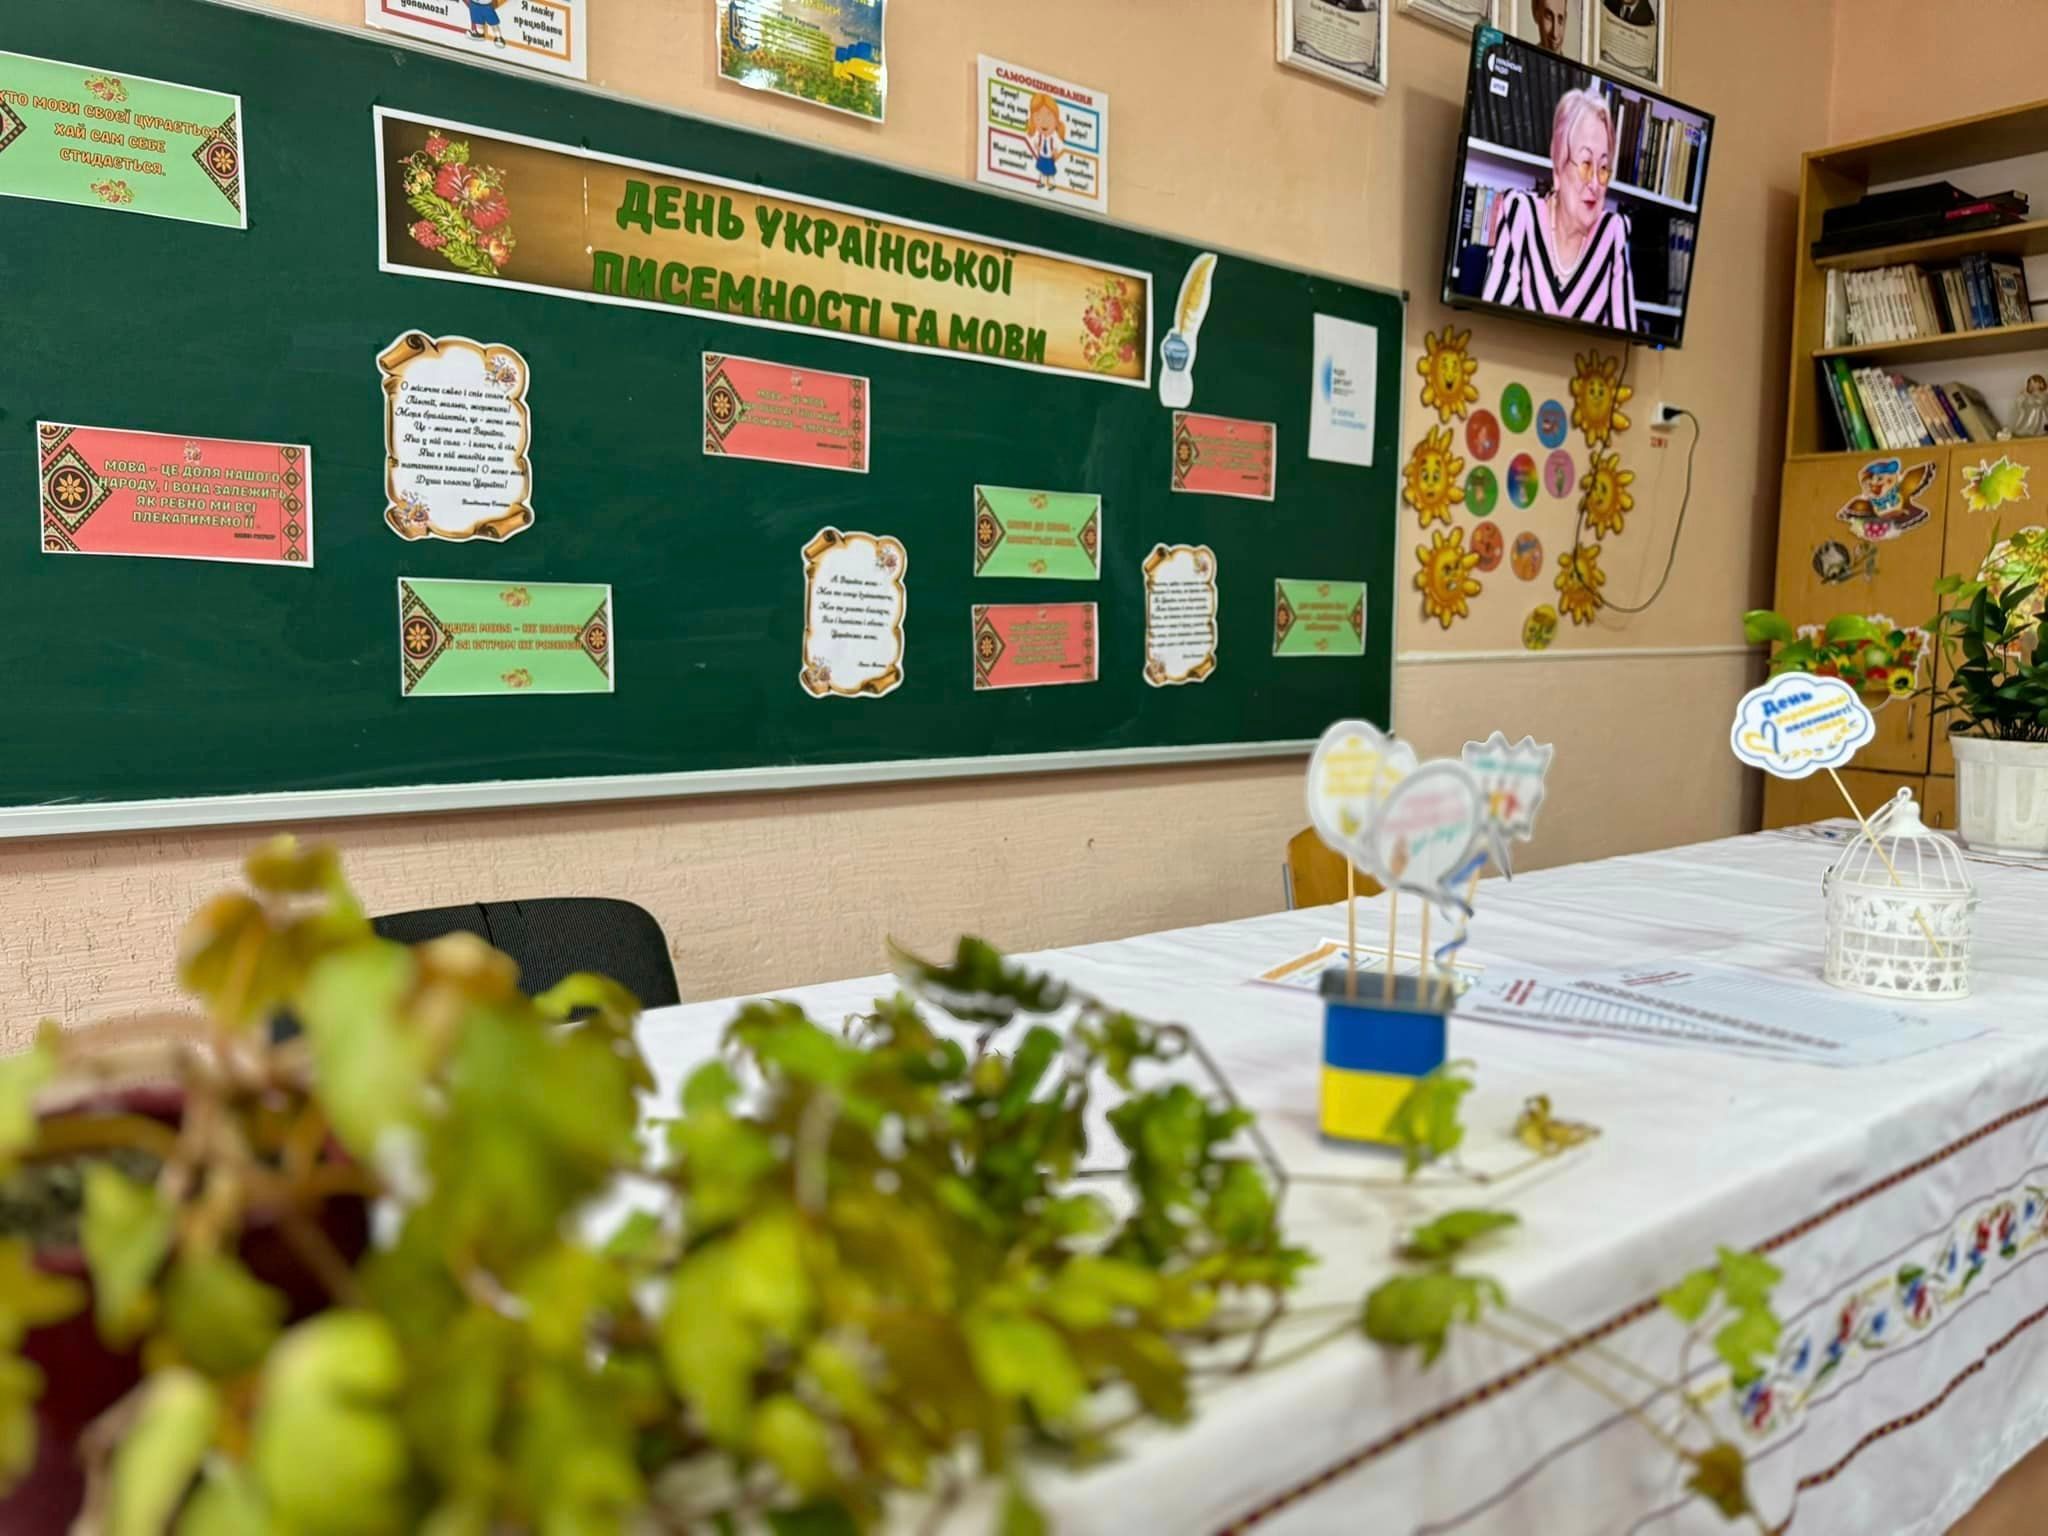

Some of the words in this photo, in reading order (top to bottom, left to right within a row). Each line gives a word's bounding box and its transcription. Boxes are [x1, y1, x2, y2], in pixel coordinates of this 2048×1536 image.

[32, 96, 81, 115] МОВИ
[84, 107, 131, 125] СВОЄЇ
[55, 122, 87, 140] ХАЙ
[90, 129, 125, 146] САМ
[129, 135, 167, 153] СЕБЕ
[59, 148, 167, 177] СТИДАЄТЬСЯ.
[616, 179, 745, 241] ДЕНЬ
[755, 205, 1018, 296] УКРАЇНСЬКОЇ
[592, 250, 882, 338] ПИСЕМНОСТІ
[892, 302, 939, 347] ТА
[948, 314, 1048, 364] МОВИ
[104, 460, 147, 474] МОВА
[160, 464, 180, 478] ЦЕ
[182, 466, 221, 480] ДОЛЯ
[225, 469, 281, 484] НАШОГО
[172, 481, 210, 495] ВОНА
[214, 485, 288, 500] ЗАЛЕЖИТЬ
[136, 495, 156, 507] ЯК
[160, 497, 206, 511] РЕВНО
[211, 500, 231, 512] МИ
[235, 501, 257, 514] ВСІ
[133, 511, 240, 528] ПЛЕКАТИМЕМО
[1762, 692, 1812, 716] День
